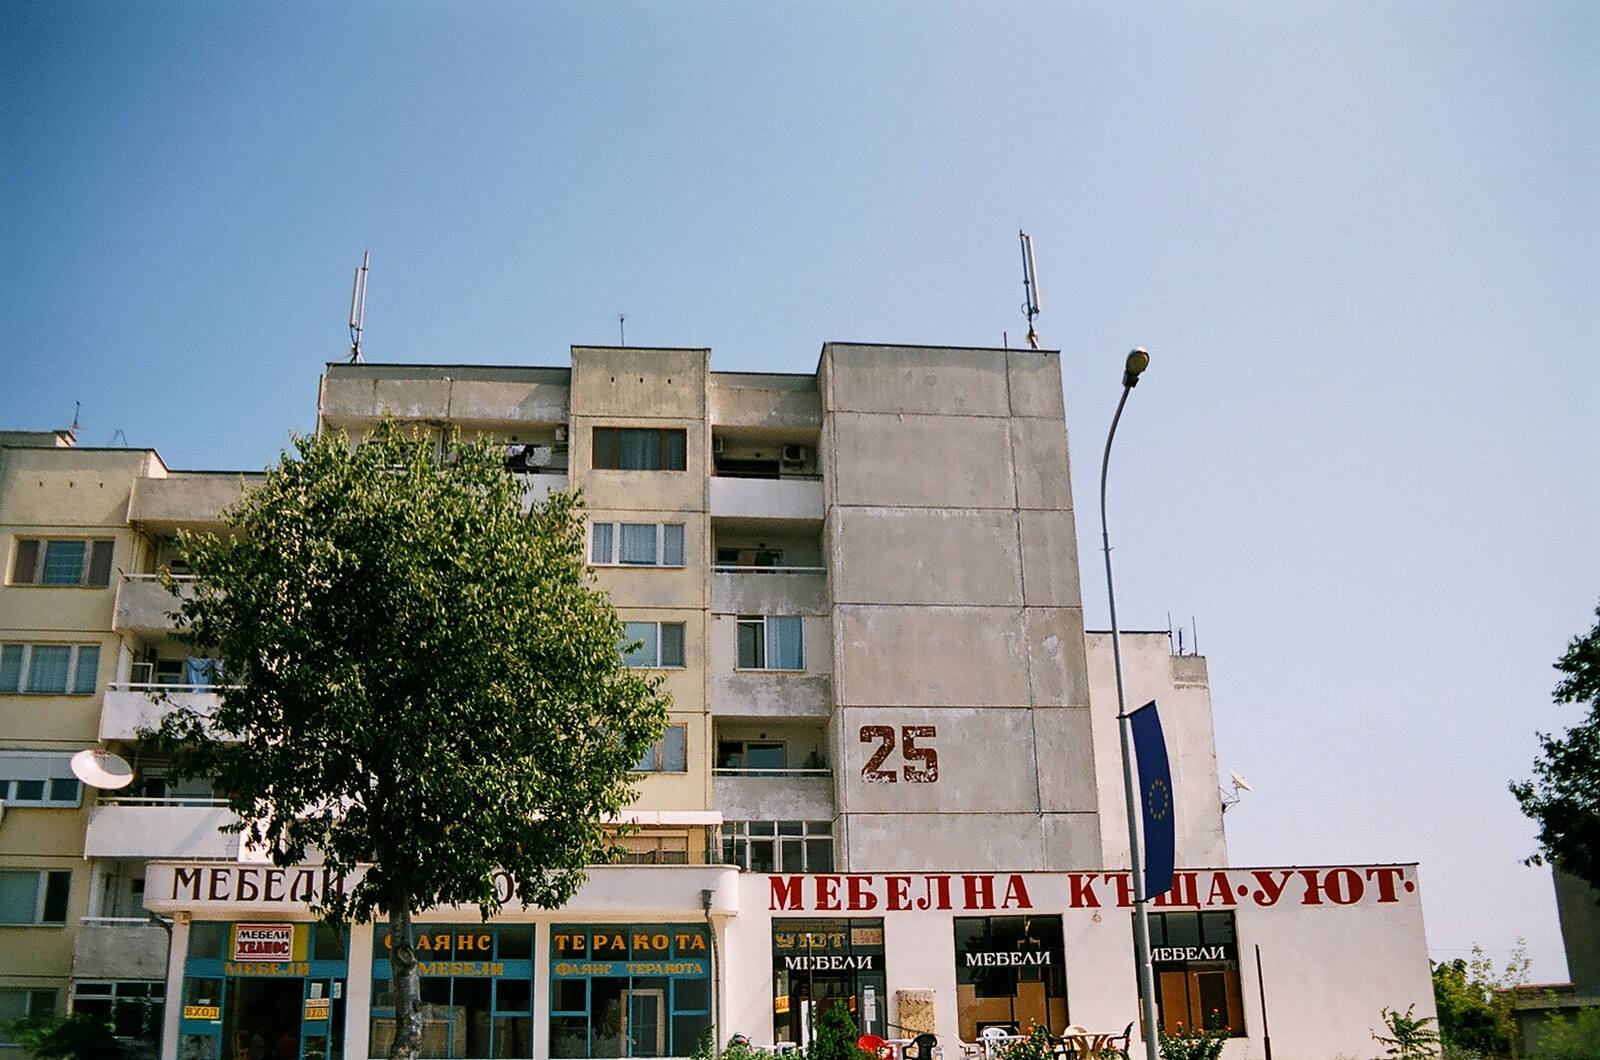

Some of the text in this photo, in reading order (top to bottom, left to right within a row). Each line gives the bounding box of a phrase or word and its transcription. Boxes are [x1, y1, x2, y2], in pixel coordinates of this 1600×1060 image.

[859, 725, 939, 784] 25
[172, 867, 345, 902] МЕБЕЛИ
[768, 873, 1033, 911] МЕБЕЛНА
[239, 930, 289, 940] МЕБЕЛИ
[384, 933, 491, 951] АЯНС
[554, 933, 706, 951] ТЕРАКОТА
[785, 955, 873, 970] МЕБЕЛИ
[965, 951, 1051, 967] МЕБЕЛИ
[186, 1008, 218, 1018] ВХОД
